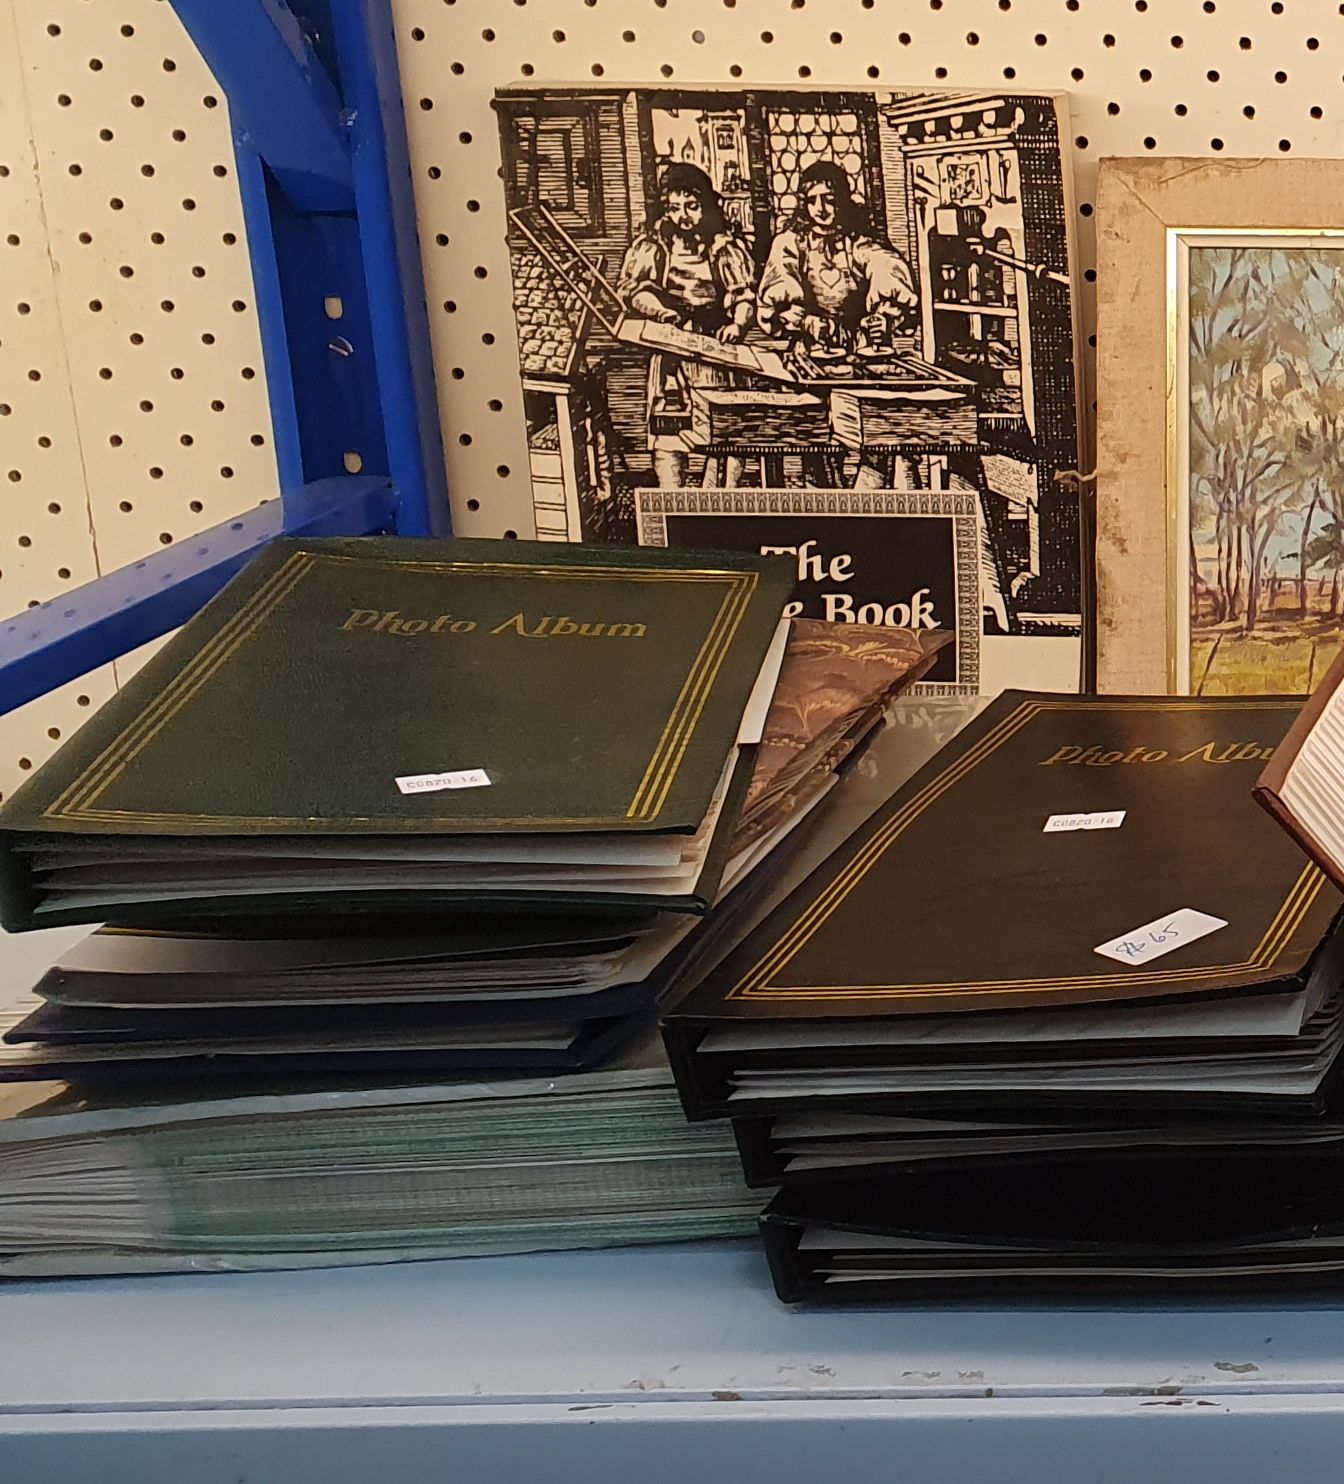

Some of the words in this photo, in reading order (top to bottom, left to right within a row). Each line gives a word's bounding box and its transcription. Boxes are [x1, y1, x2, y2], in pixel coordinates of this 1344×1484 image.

[760, 540, 855, 582] he
[339, 609, 478, 636] Photo
[490, 612, 648, 638] Album
[821, 588, 941, 629] Book
[1039, 744, 1168, 766] Photo
[1178, 741, 1277, 763] Albu
